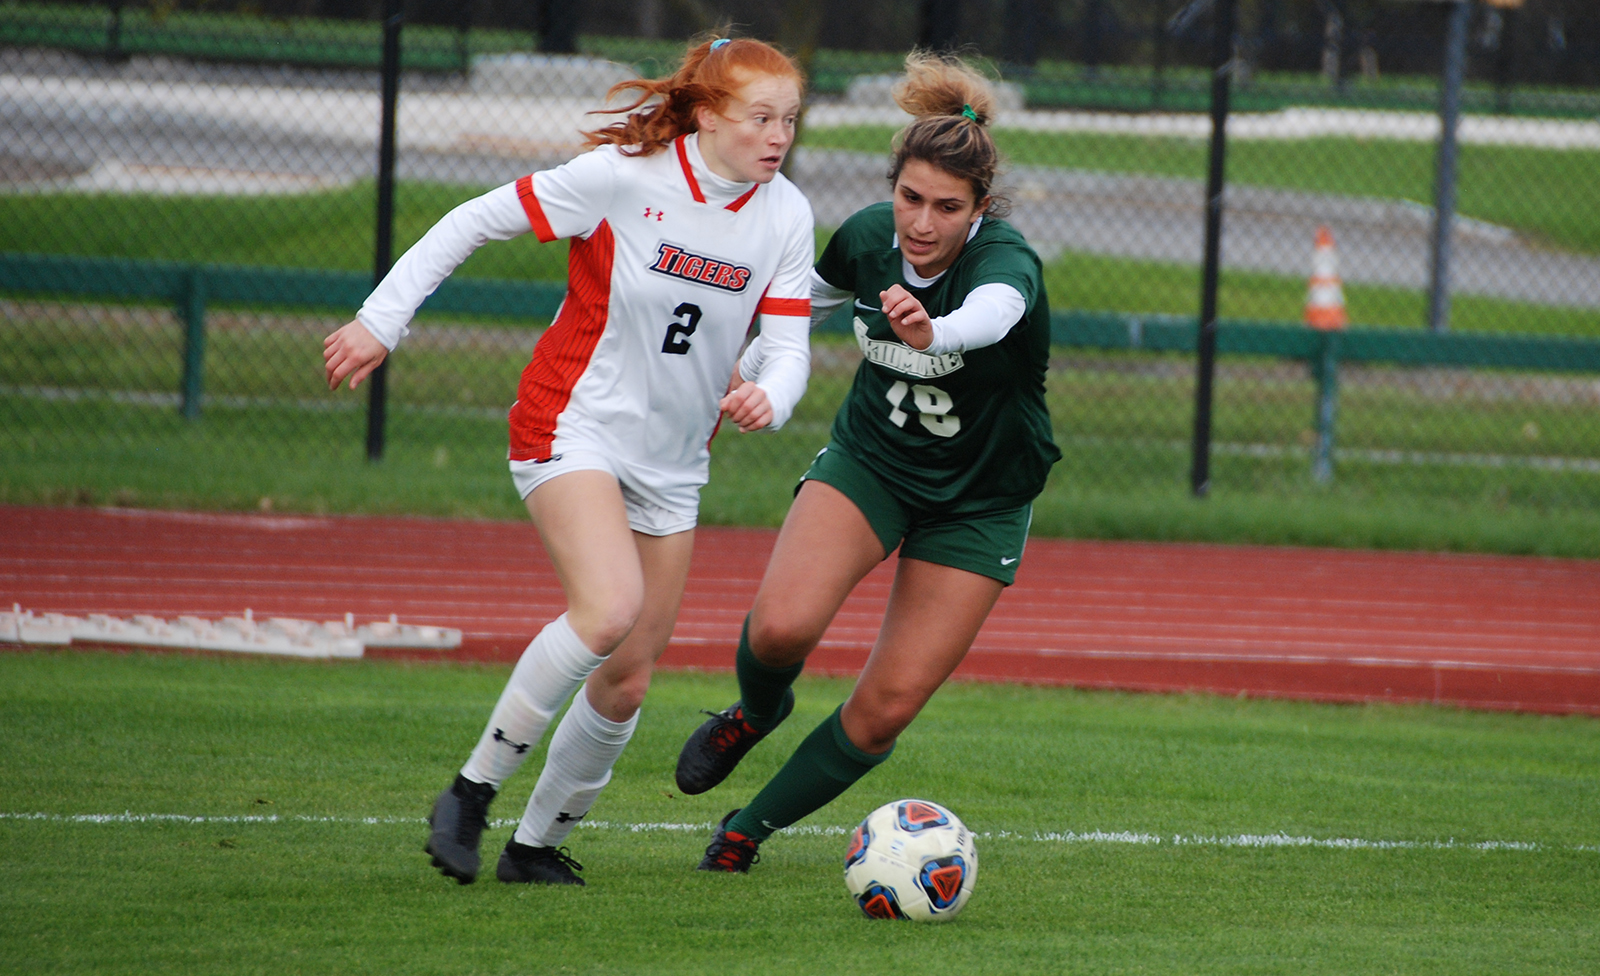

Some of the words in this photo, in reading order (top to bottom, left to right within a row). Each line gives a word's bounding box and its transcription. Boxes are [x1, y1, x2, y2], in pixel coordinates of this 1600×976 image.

[649, 243, 751, 292] TIGERS
[661, 302, 703, 355] 2
[885, 380, 962, 438] 18
